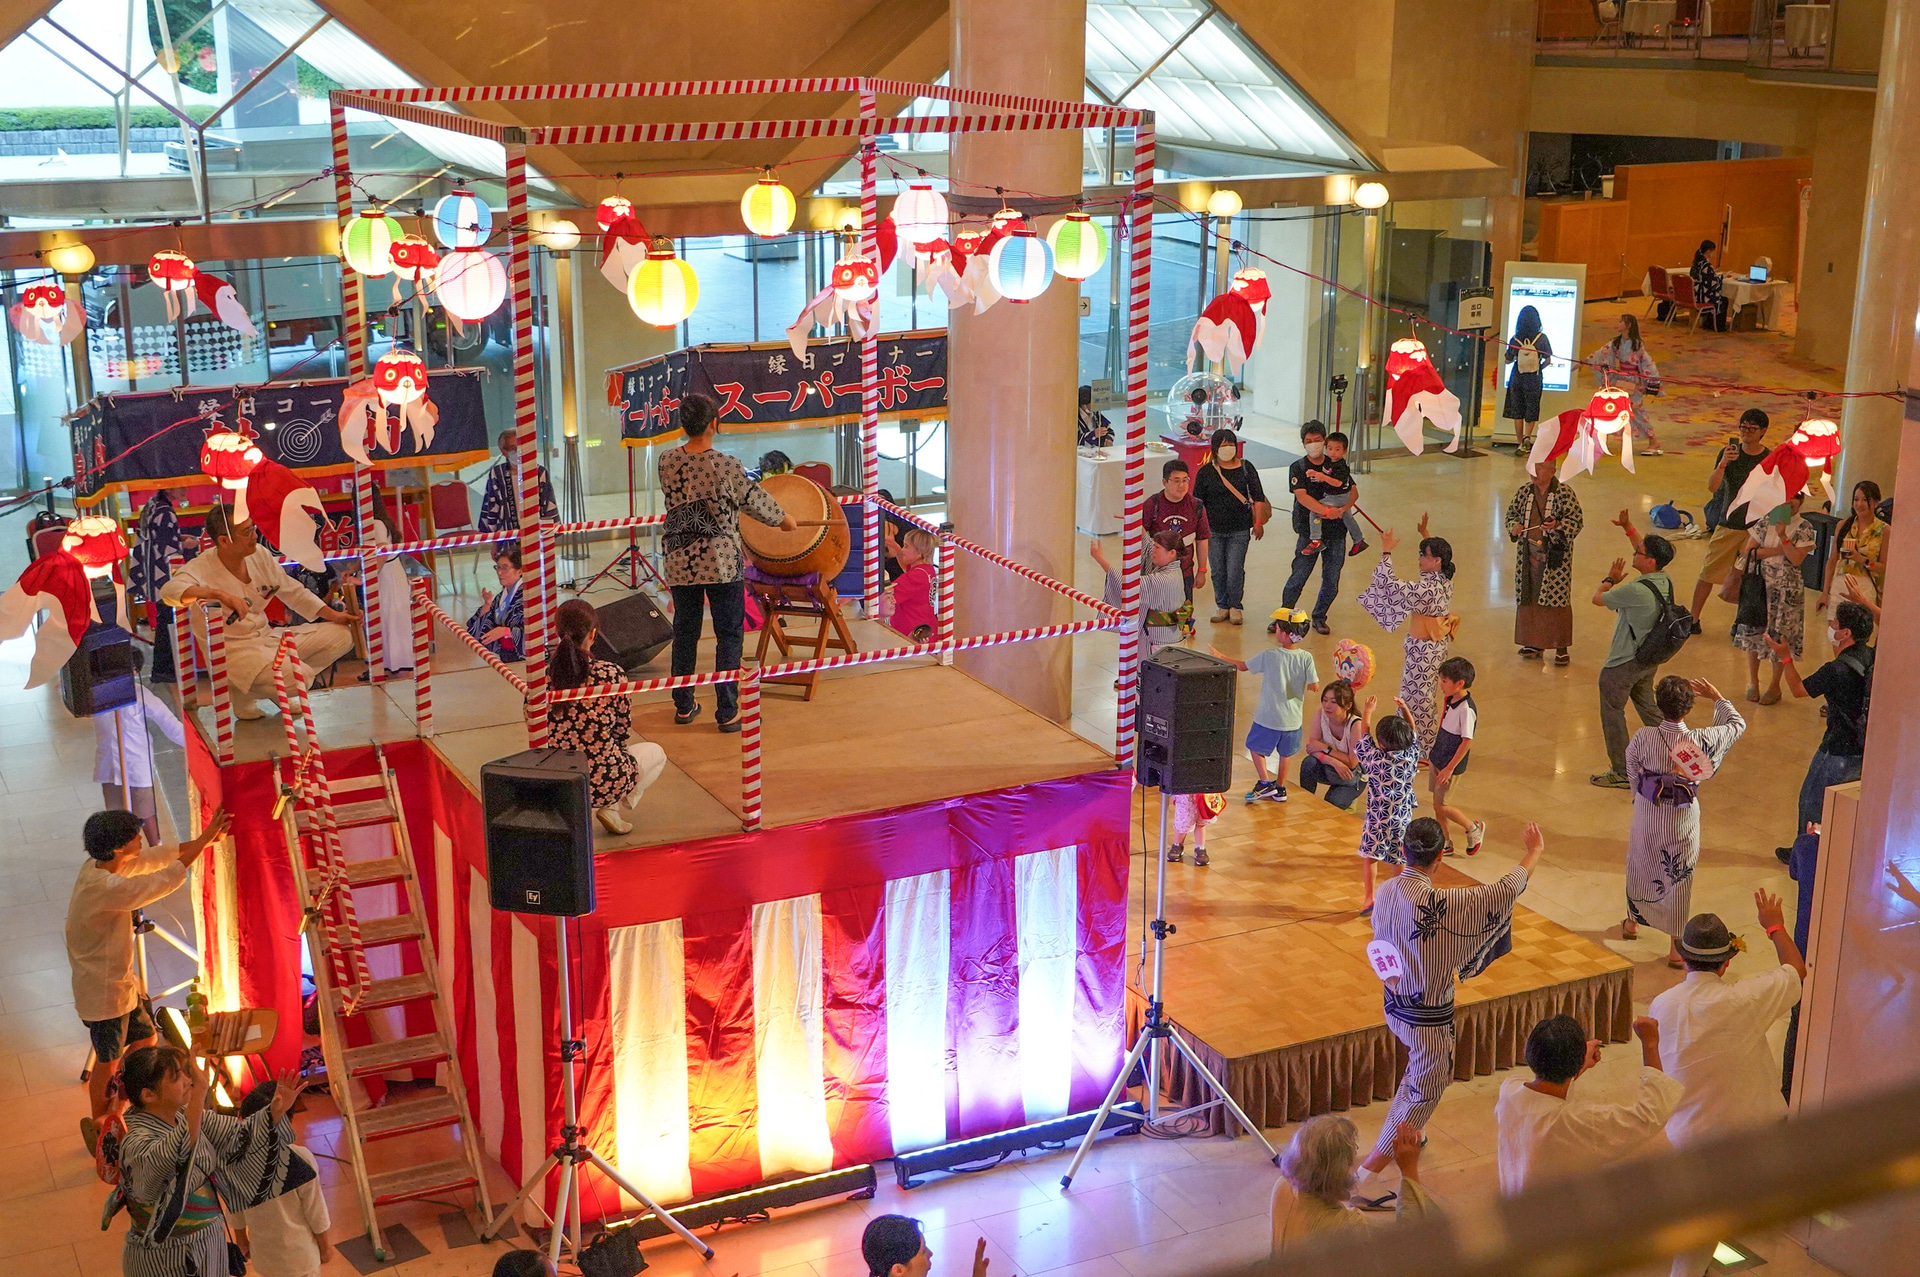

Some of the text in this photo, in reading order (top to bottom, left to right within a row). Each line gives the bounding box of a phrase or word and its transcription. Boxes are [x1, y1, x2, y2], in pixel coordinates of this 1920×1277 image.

[1471, 303, 1482, 311] 出口
[767, 345, 934, 375] 縁日コナー
[627, 364, 686, 396] 縁日コーナー
[713, 364, 947, 420] スーパーボー
[198, 396, 333, 422] 縁日コー
